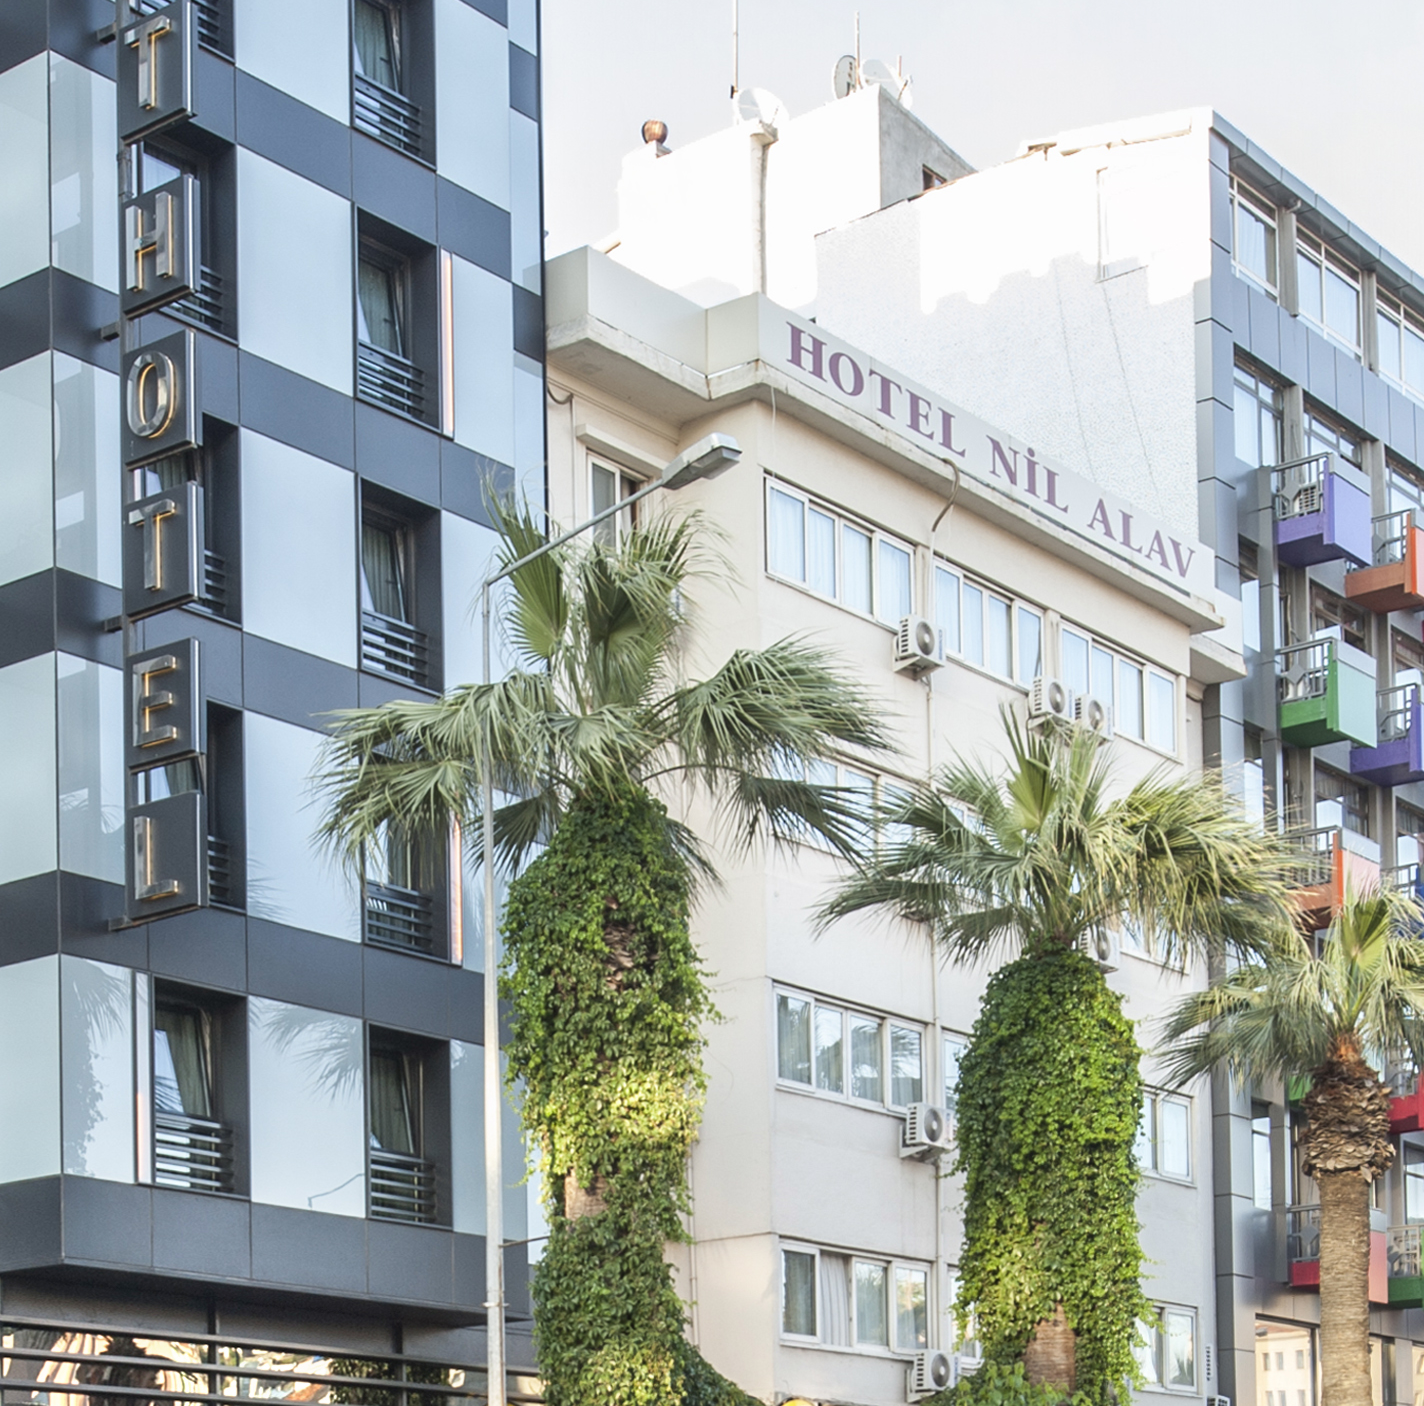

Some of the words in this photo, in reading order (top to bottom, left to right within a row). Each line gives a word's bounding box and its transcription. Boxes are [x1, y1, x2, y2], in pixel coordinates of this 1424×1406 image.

[124, 188, 179, 903] HOTEL
[785, 320, 967, 458] HOTEL
[986, 433, 1069, 514] NİL
[1086, 498, 1197, 579] ALAV
